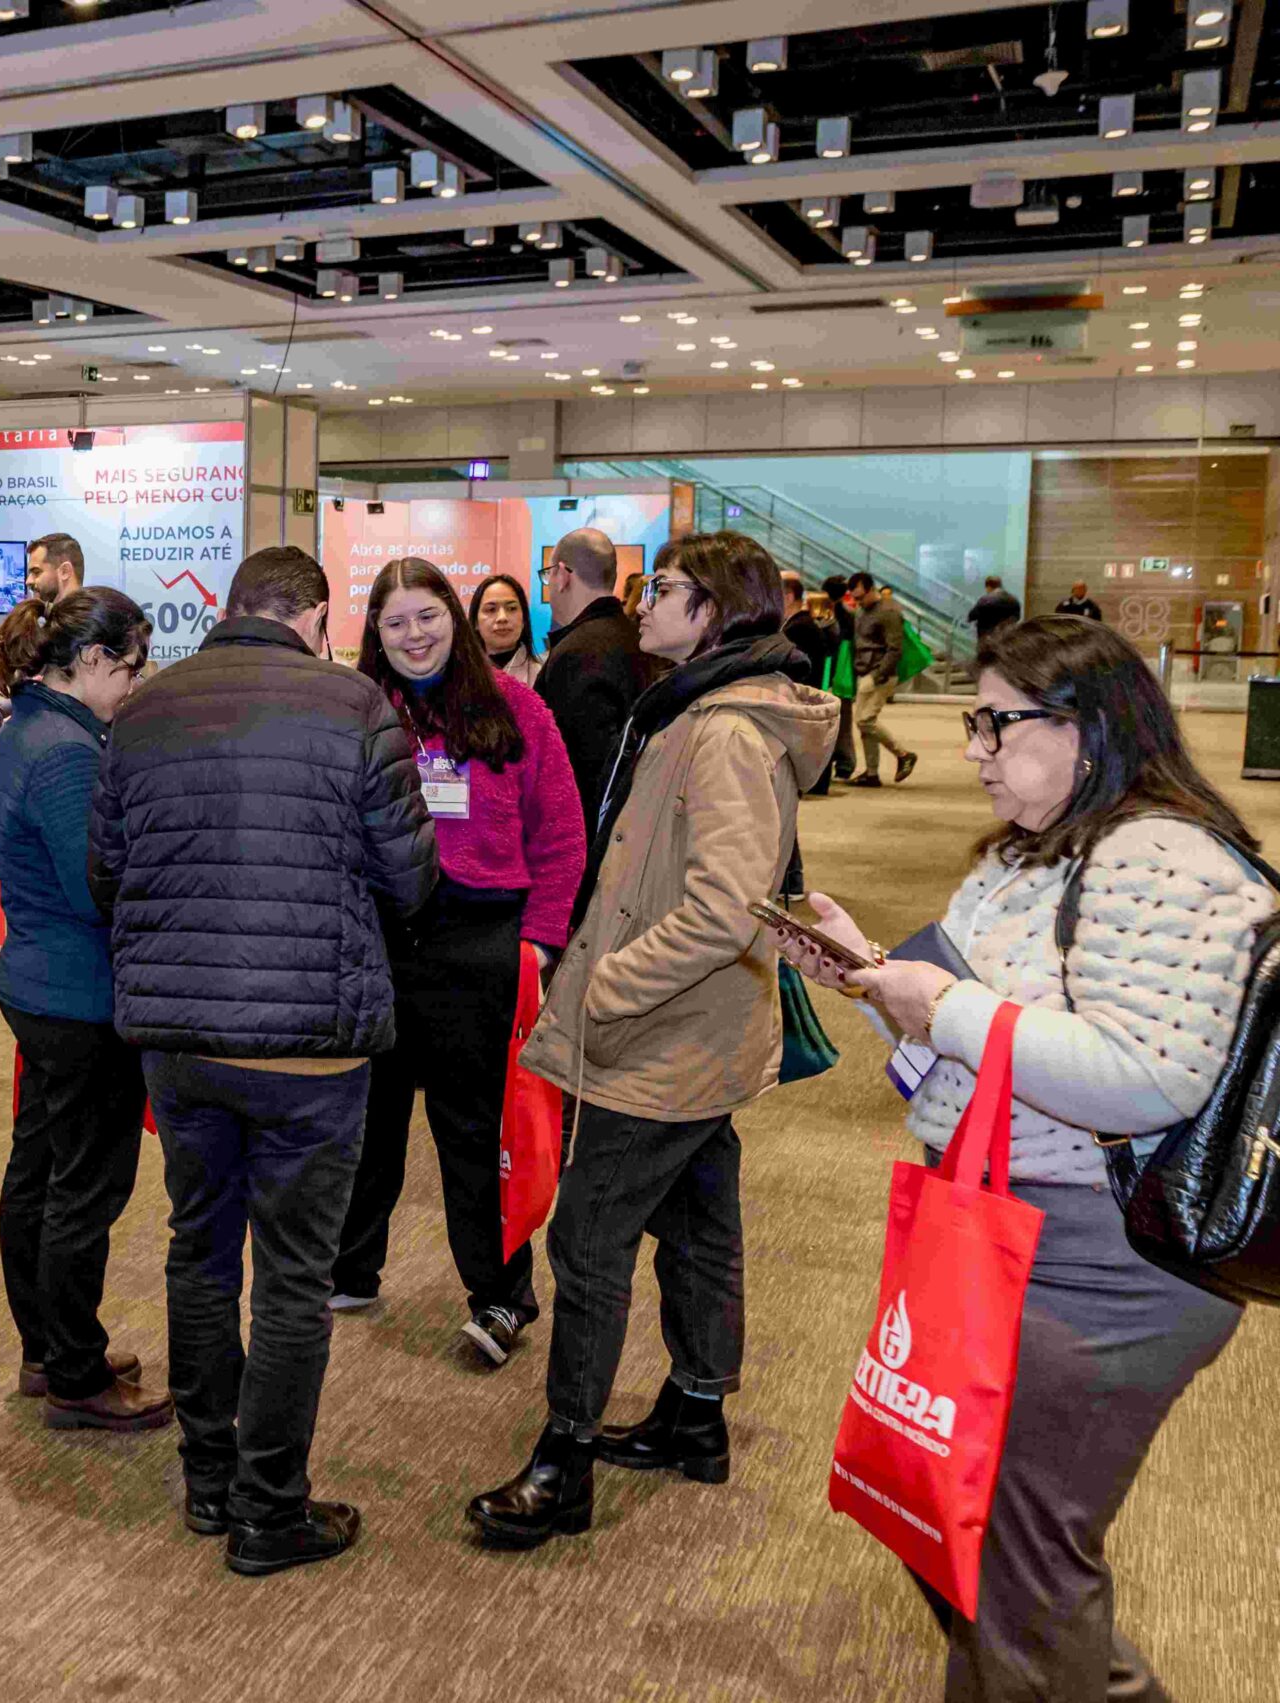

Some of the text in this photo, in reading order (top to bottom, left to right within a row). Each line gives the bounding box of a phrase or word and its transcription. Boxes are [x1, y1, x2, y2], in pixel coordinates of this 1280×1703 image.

[7, 476, 58, 489] BRASIL
[95, 468, 137, 484] MAIS
[85, 489, 128, 504] PELO
[135, 488, 204, 504] MENOR
[120, 525, 232, 541] AJUDAMOS A
[120, 542, 232, 561] REDUZIR ATÉ
[350, 543, 454, 558] Abra as portas
[350, 560, 491, 578] para ndo de
